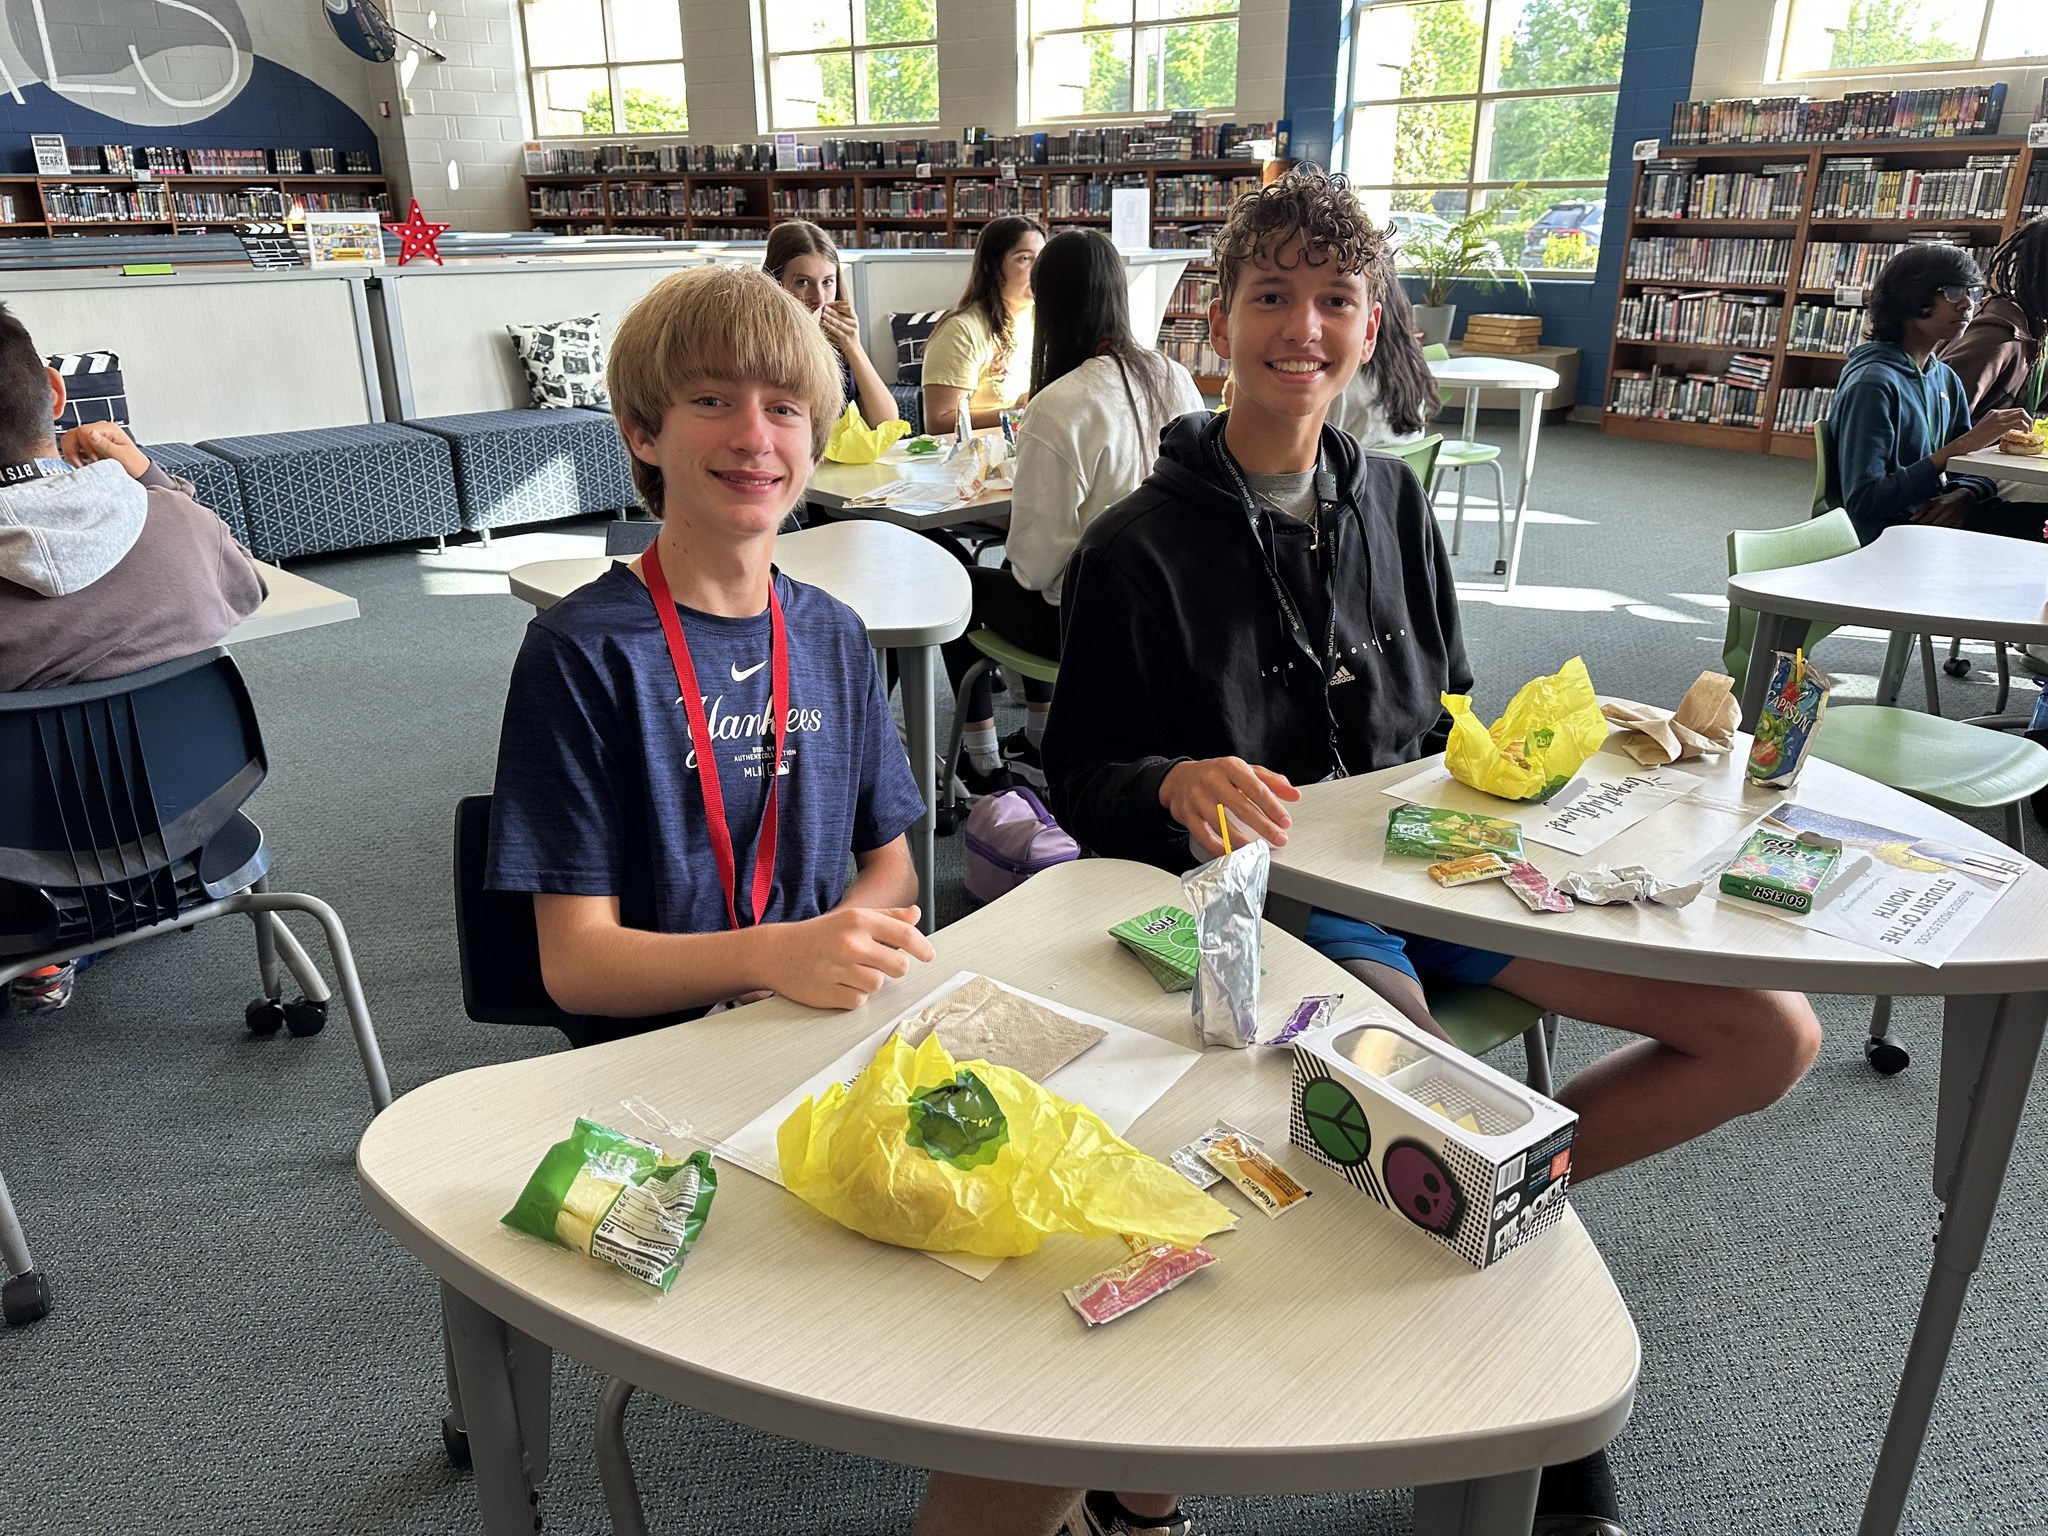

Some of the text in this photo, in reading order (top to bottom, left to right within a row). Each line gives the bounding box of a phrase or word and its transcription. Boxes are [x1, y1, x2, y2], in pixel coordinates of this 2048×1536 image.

[6, 463, 34, 481] BTS
[1261, 629, 1406, 677] LOS NGELES
[1329, 674, 1356, 686] adidas
[1786, 705, 1811, 734] SUN
[1545, 776, 1654, 836] Congratulations!
[1761, 839, 1796, 849] GO
[1752, 886, 1787, 904] FISH
[1786, 894, 1808, 909] GO
[1872, 887, 1917, 920] MONTH
[1879, 879, 1957, 945] STUDENT OF THE
[1142, 915, 1177, 936] FISH
[1242, 1177, 1277, 1208] Mustard
[600, 1221, 616, 1234] 15
[637, 1240, 677, 1257] Calories
